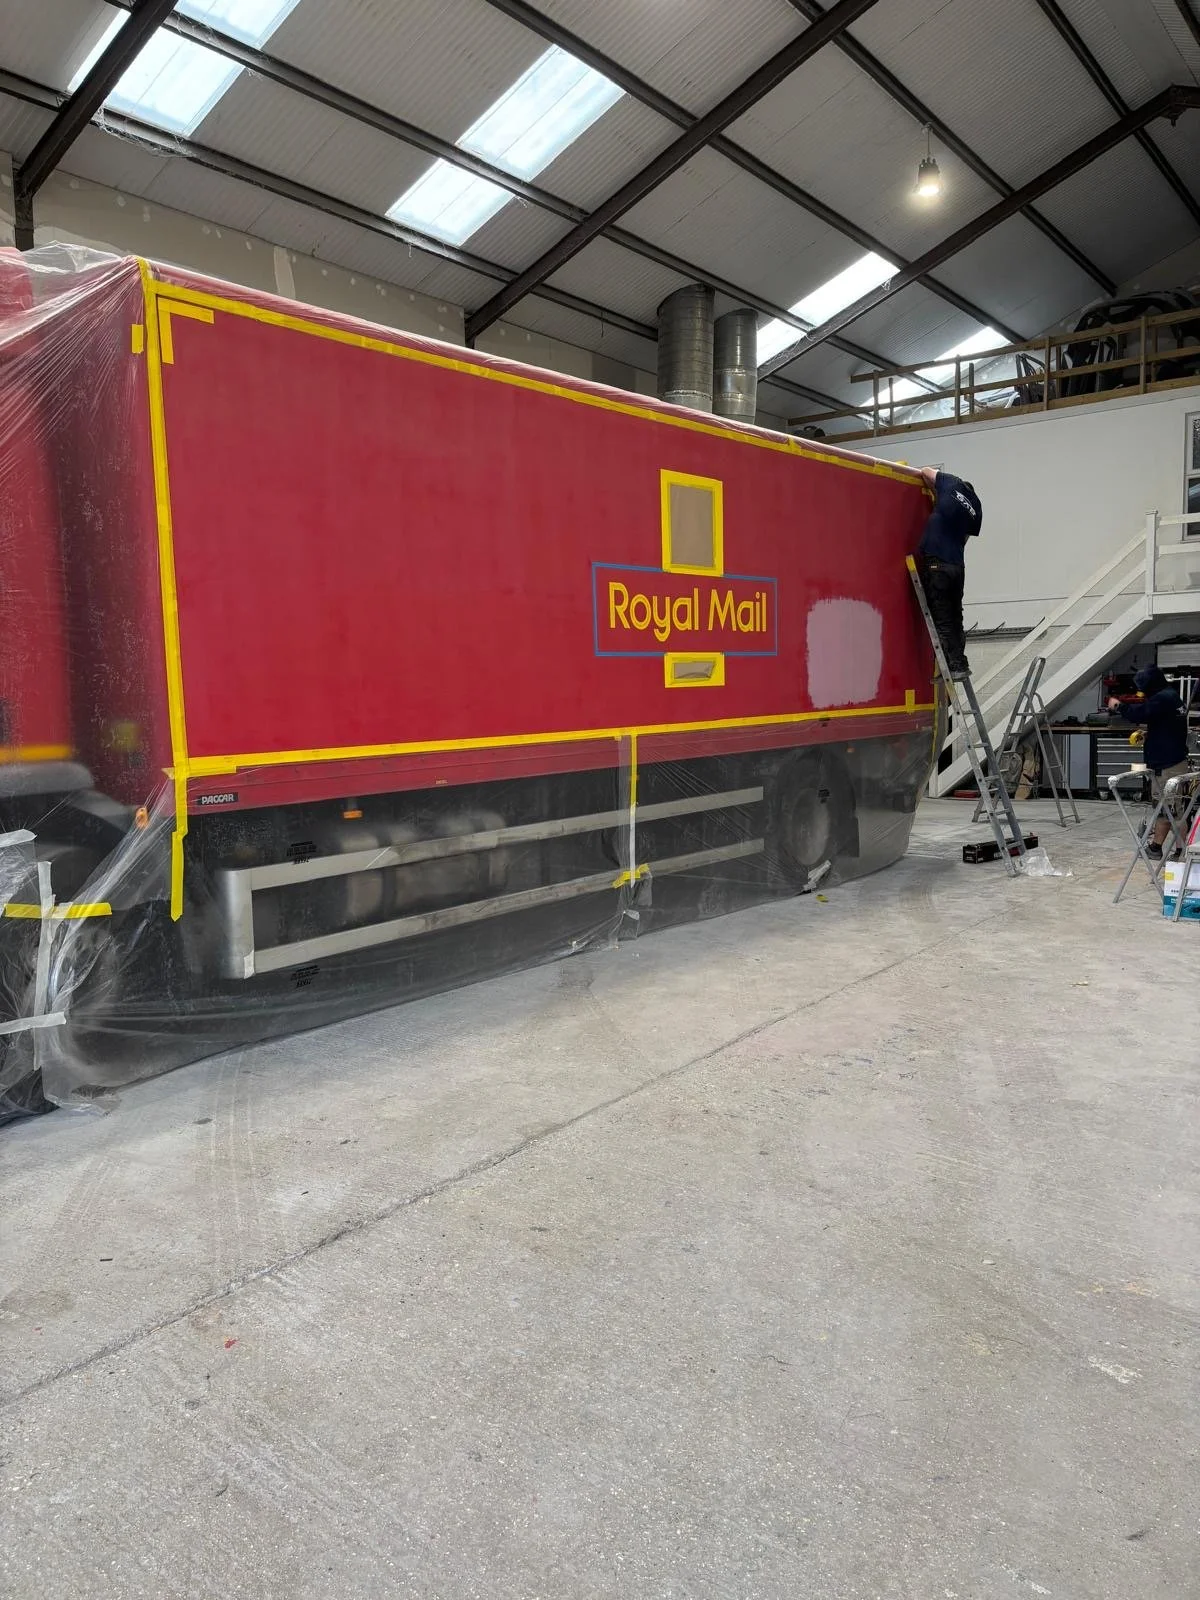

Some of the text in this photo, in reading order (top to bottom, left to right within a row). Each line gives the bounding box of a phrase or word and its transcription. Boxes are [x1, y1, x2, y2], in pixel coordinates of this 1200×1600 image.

[608, 581, 767, 642] Royal Mail
[201, 793, 234, 805] PACCAR
